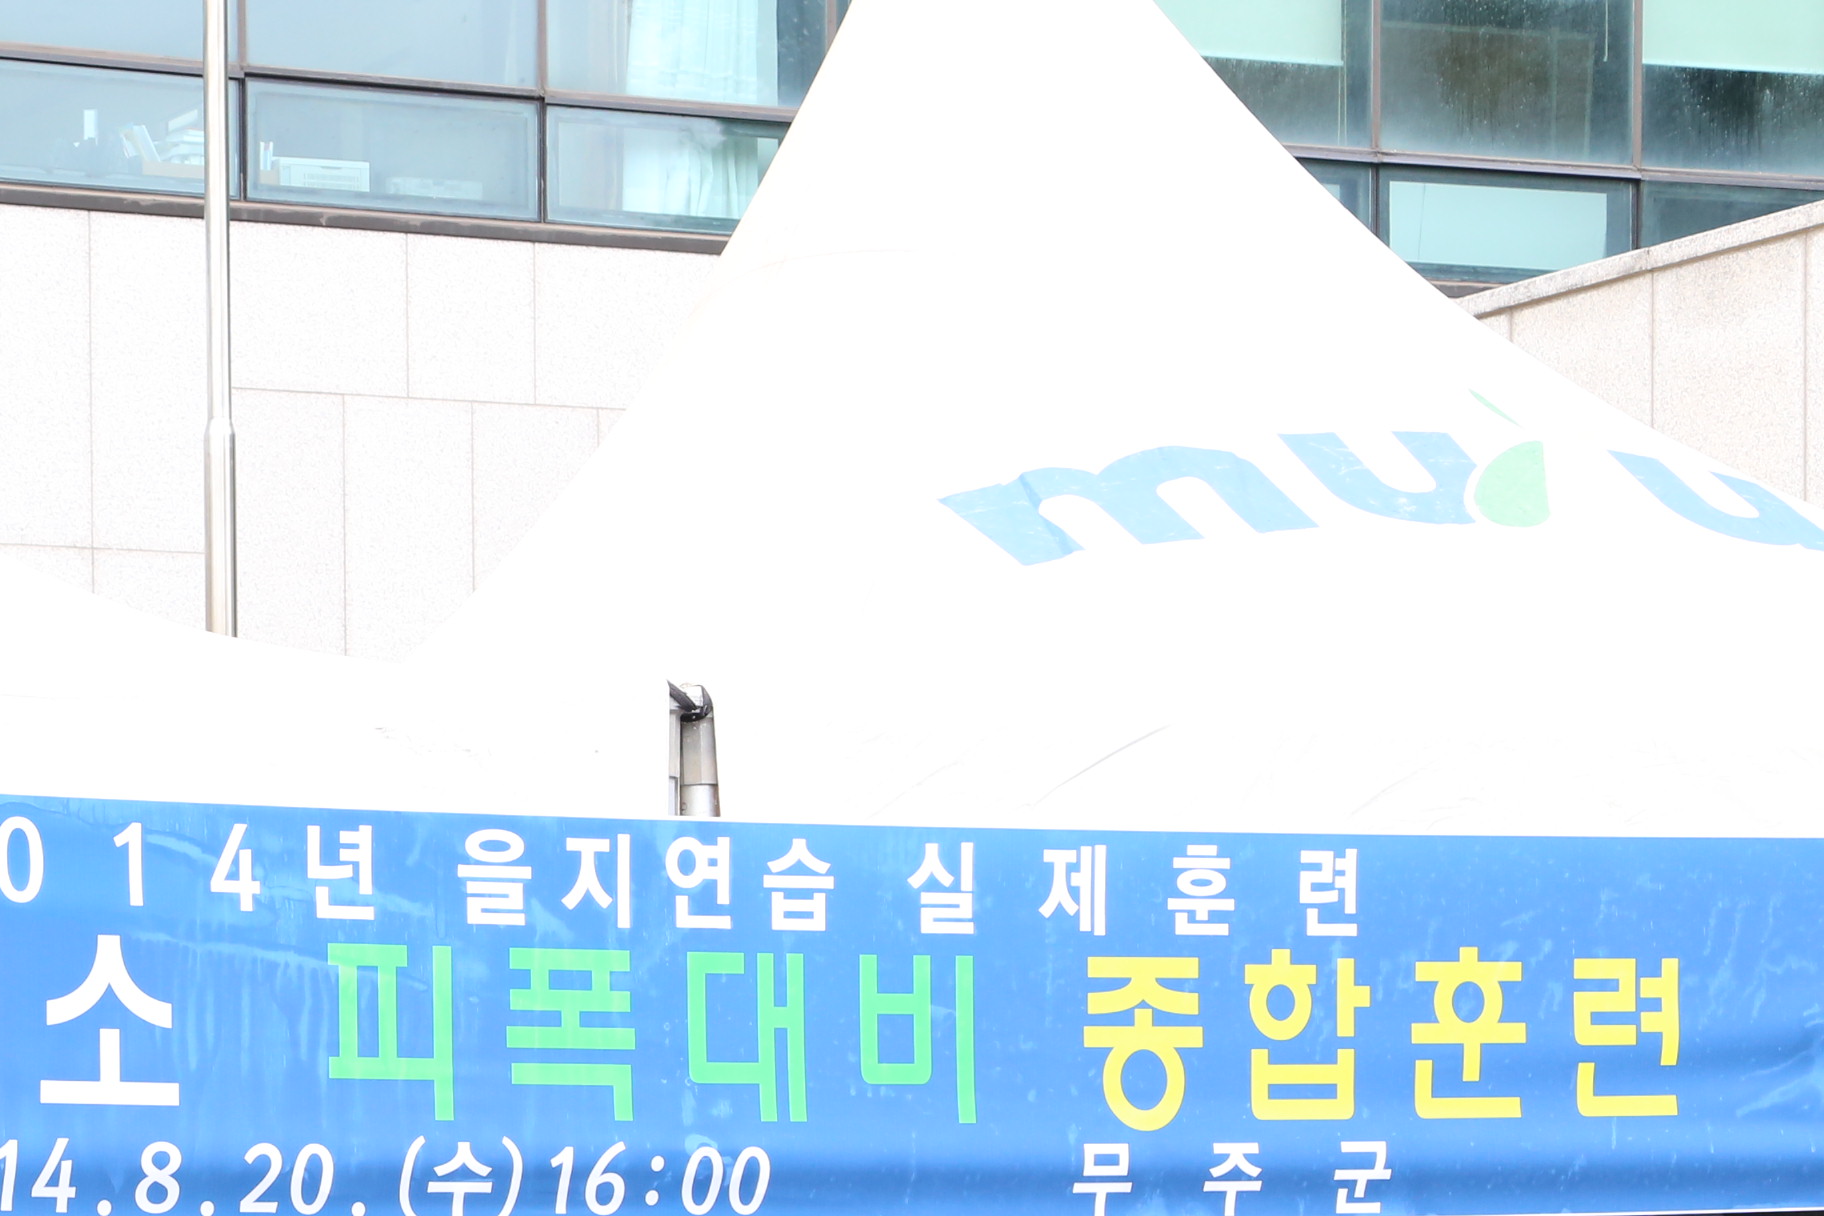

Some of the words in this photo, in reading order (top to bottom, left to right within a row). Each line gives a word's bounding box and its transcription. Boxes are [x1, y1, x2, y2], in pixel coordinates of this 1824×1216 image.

[458, 829, 834, 931] 을지연습
[329, 944, 976, 1123] 피폭대비
[1085, 948, 1679, 1130] 종합훈련
